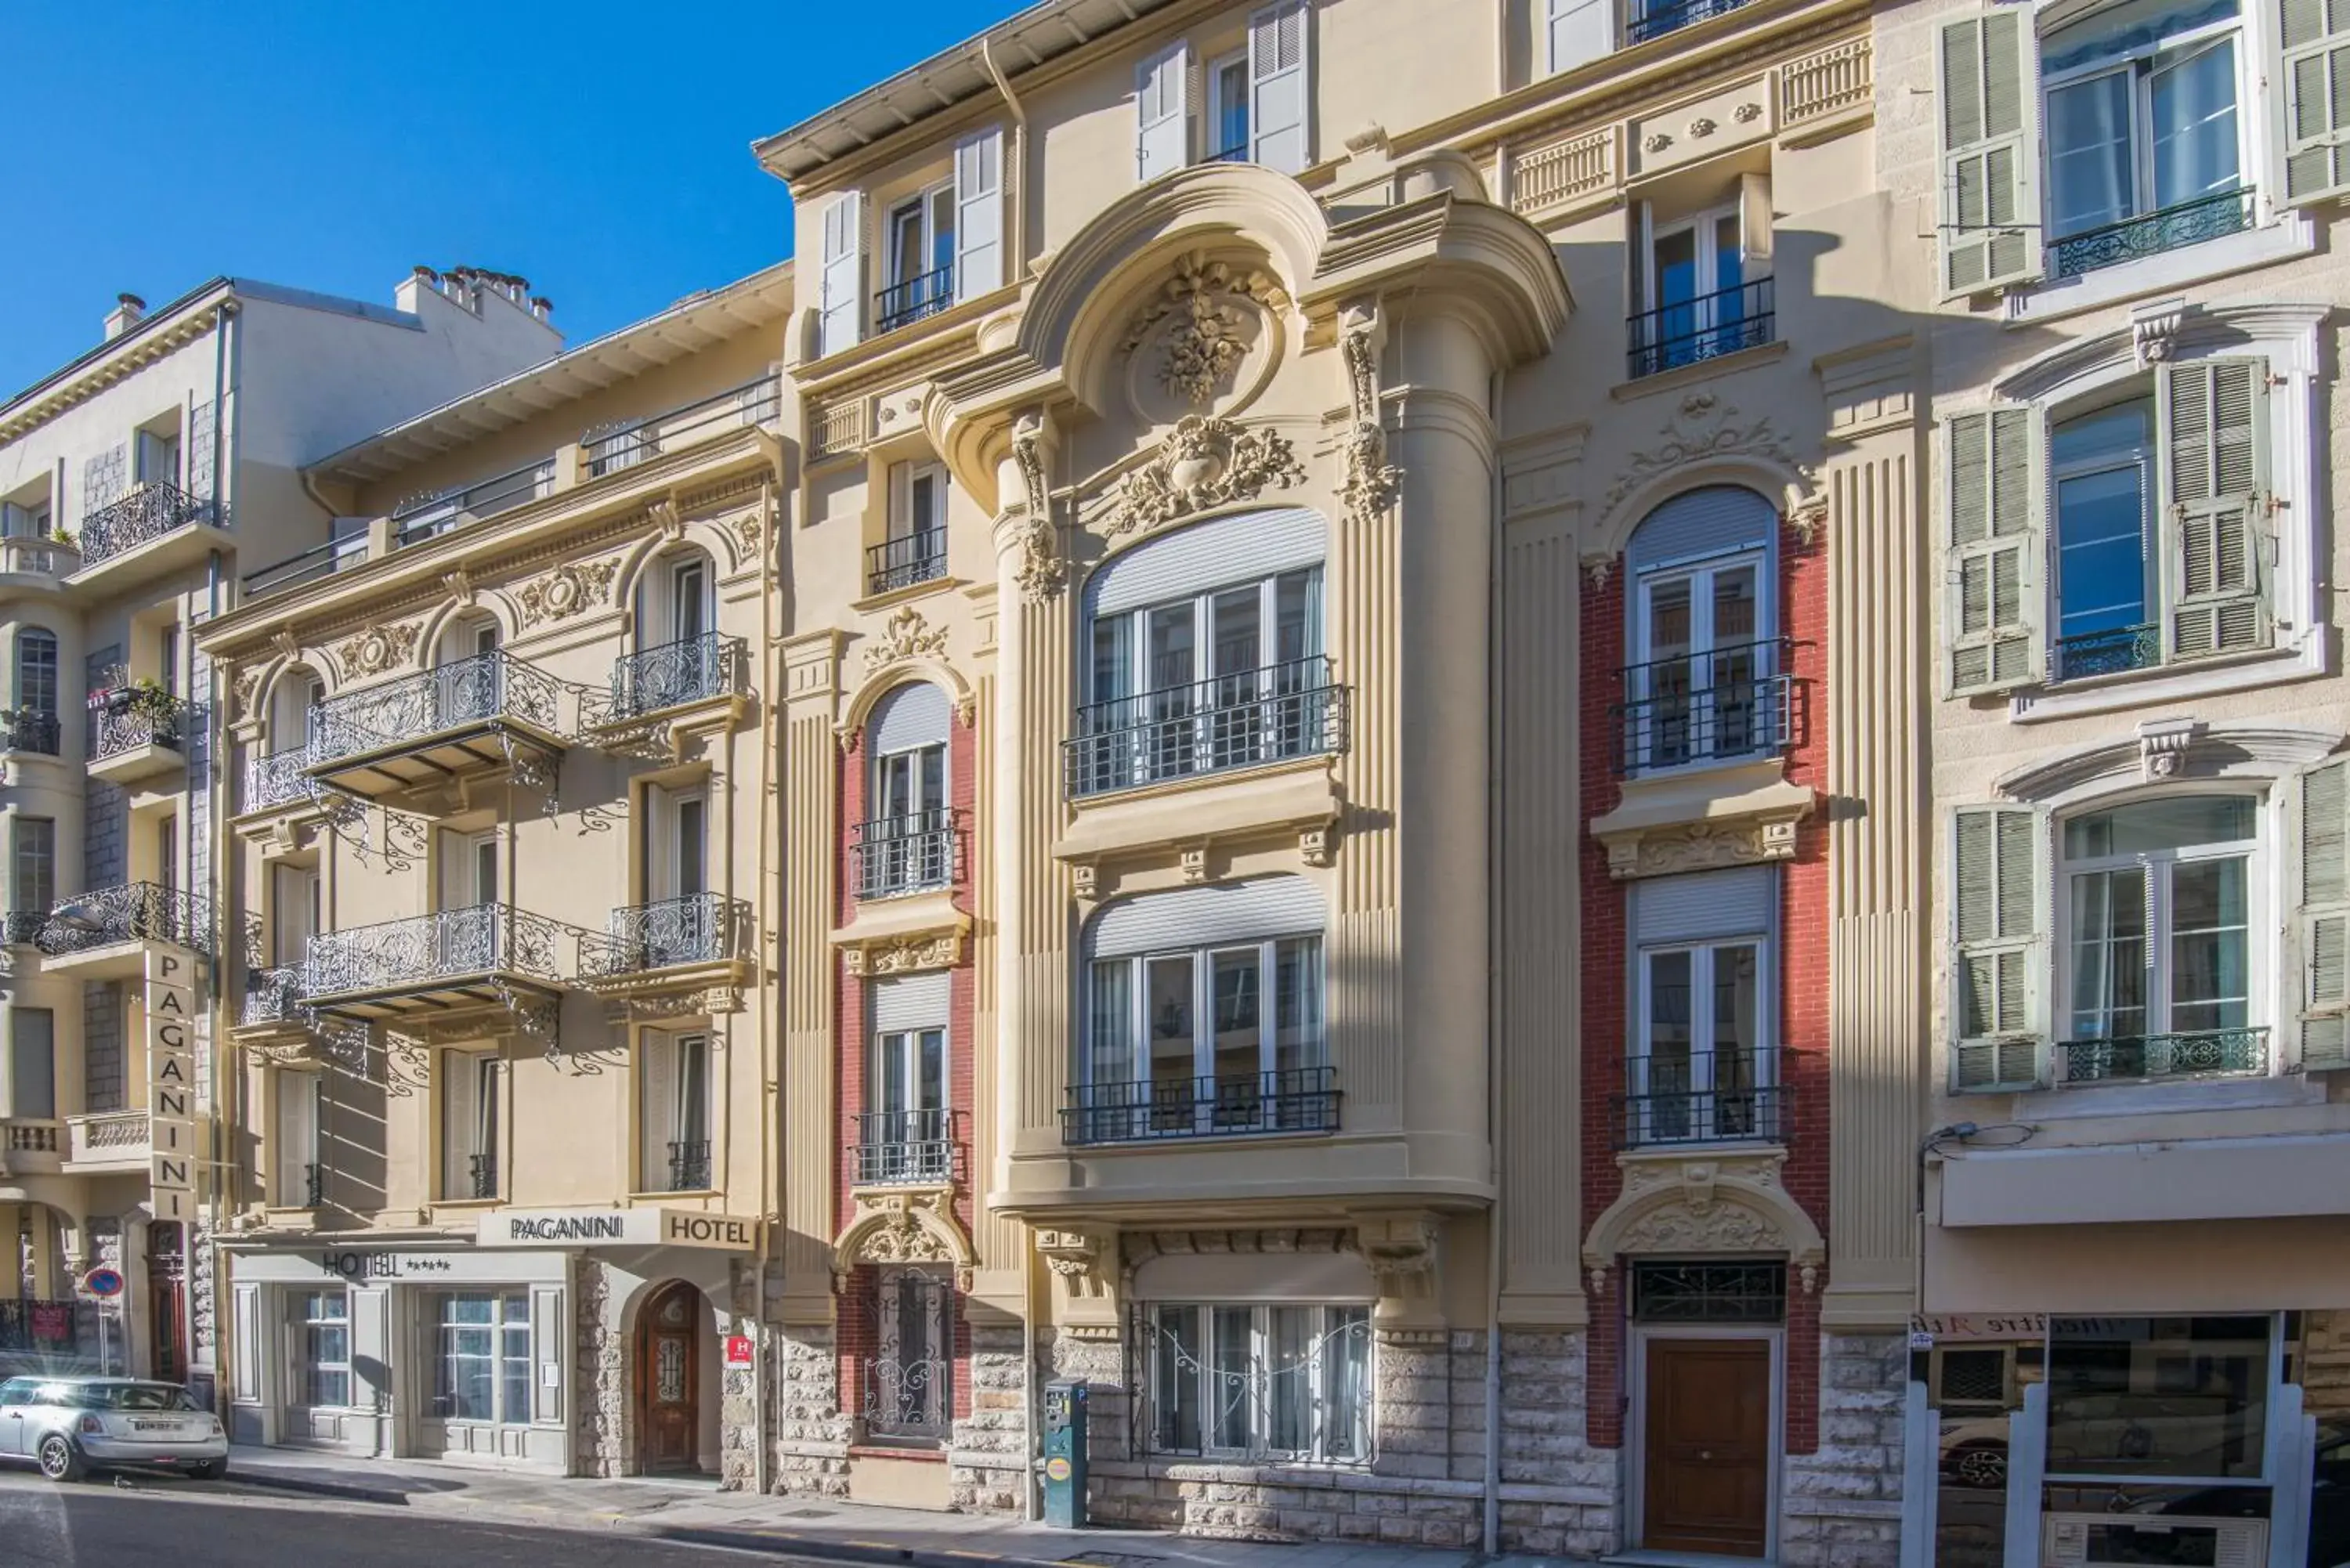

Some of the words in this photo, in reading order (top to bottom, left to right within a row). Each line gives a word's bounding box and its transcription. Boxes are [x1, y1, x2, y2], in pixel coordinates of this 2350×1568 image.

[159, 955, 186, 1216] PAGANINI
[511, 1216, 624, 1240] PAGANINI
[671, 1216, 750, 1244] HOTEL
[323, 1252, 400, 1277] HOTEL
[738, 1342, 748, 1352] H
